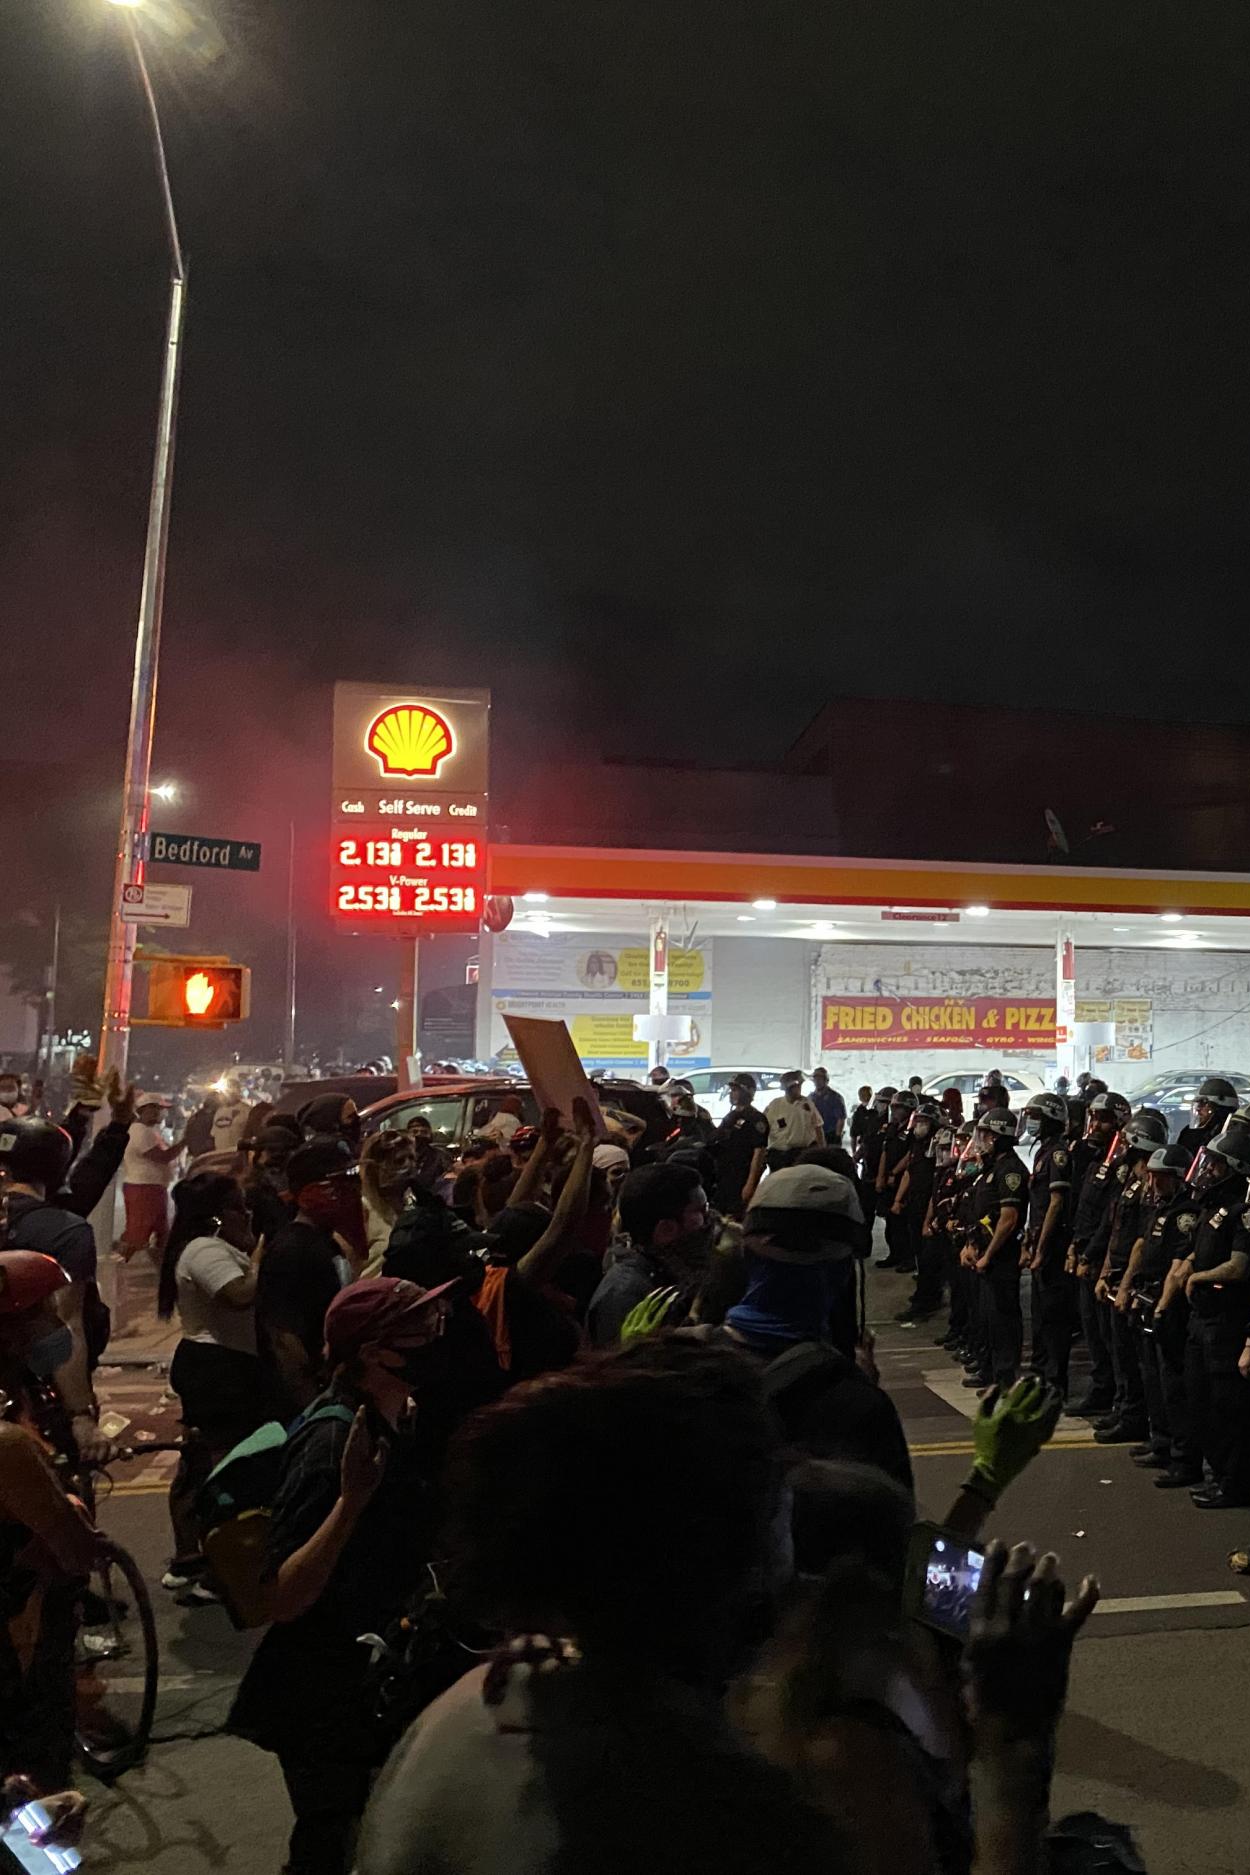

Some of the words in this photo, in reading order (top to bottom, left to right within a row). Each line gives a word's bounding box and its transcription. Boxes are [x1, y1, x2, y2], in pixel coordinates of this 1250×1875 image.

[341, 800, 365, 813] Cash
[378, 799, 404, 814] Self
[405, 801, 441, 815] Serve
[449, 804, 477, 817] Credit
[391, 828, 428, 842] Regular
[154, 837, 230, 865] Bedford
[239, 846, 253, 859] Av
[389, 875, 428, 886] V-Power
[825, 1006, 893, 1030] FRIED
[901, 1007, 975, 1030] CHICKEN
[982, 1008, 999, 1029] &
[1005, 1007, 1056, 1030] PIZZ
[925, 1034, 974, 1043] SEAFOOD
[986, 1035, 1015, 1043] GYRO
